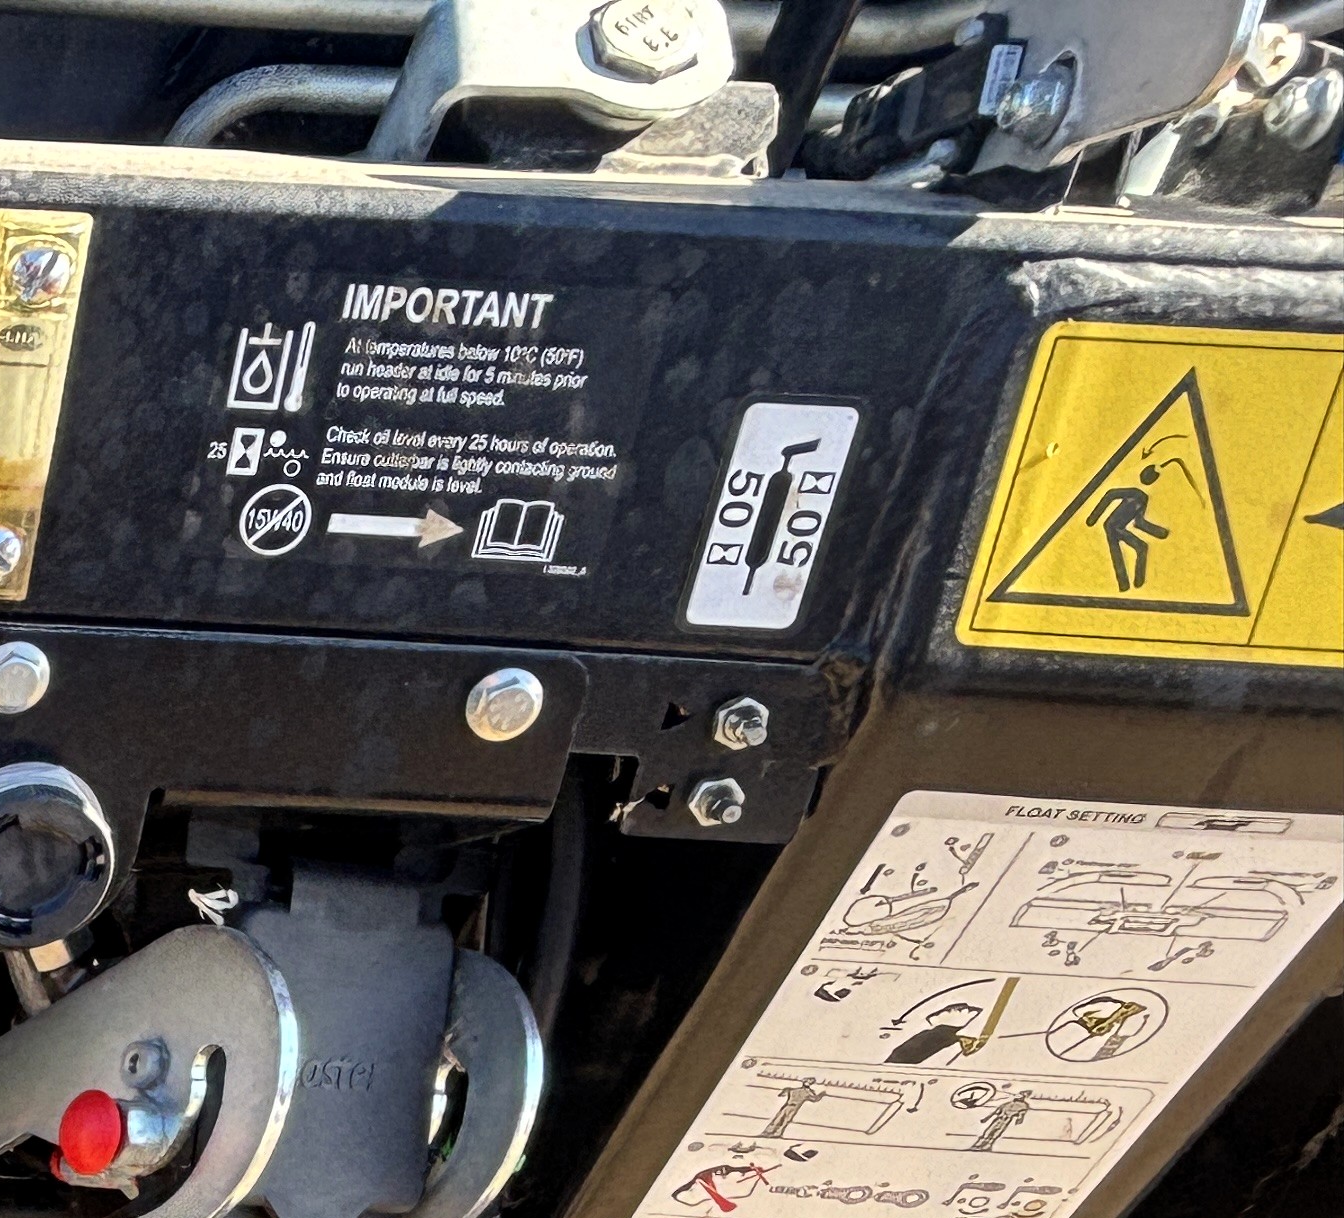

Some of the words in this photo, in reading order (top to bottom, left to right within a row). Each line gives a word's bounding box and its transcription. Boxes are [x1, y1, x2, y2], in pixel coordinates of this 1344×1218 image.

[342, 283, 555, 328] IMPORTANT
[345, 337, 361, 354] At
[364, 340, 454, 361] temperatures
[459, 343, 500, 362] below
[341, 361, 364, 377] run
[366, 360, 416, 380] header
[417, 364, 432, 381] at
[434, 363, 459, 382] idle
[462, 365, 483, 384] for
[484, 366, 496, 384] 5
[496, 368, 551, 388] minutes
[553, 370, 588, 391] prior
[336, 383, 351, 398] to
[353, 384, 416, 405] operating
[418, 387, 433, 403] at
[436, 386, 459, 404] full
[459, 388, 505, 408] speed.
[207, 441, 228, 459] 25
[326, 425, 370, 446] Check
[373, 429, 391, 446] oil
[392, 428, 426, 448] level
[428, 434, 466, 452] every
[469, 432, 488, 451] 25
[490, 434, 529, 453] hours
[532, 437, 548, 455] of
[549, 438, 617, 458] operation.
[321, 447, 371, 466] Ensure
[373, 450, 433, 469] cutterbar
[437, 453, 449, 470] is
[451, 454, 494, 477] lightly
[495, 457, 564, 480] contacting
[566, 461, 617, 482] ground
[316, 470, 343, 487] and
[346, 470, 376, 488] float
[378, 473, 429, 492] module
[432, 475, 444, 492] is
[447, 476, 483, 494] level.
[718, 469, 765, 528] 50
[776, 510, 822, 568] 50
[1004, 805, 1067, 820] FLOAT
[1067, 810, 1148, 825] SETTING
